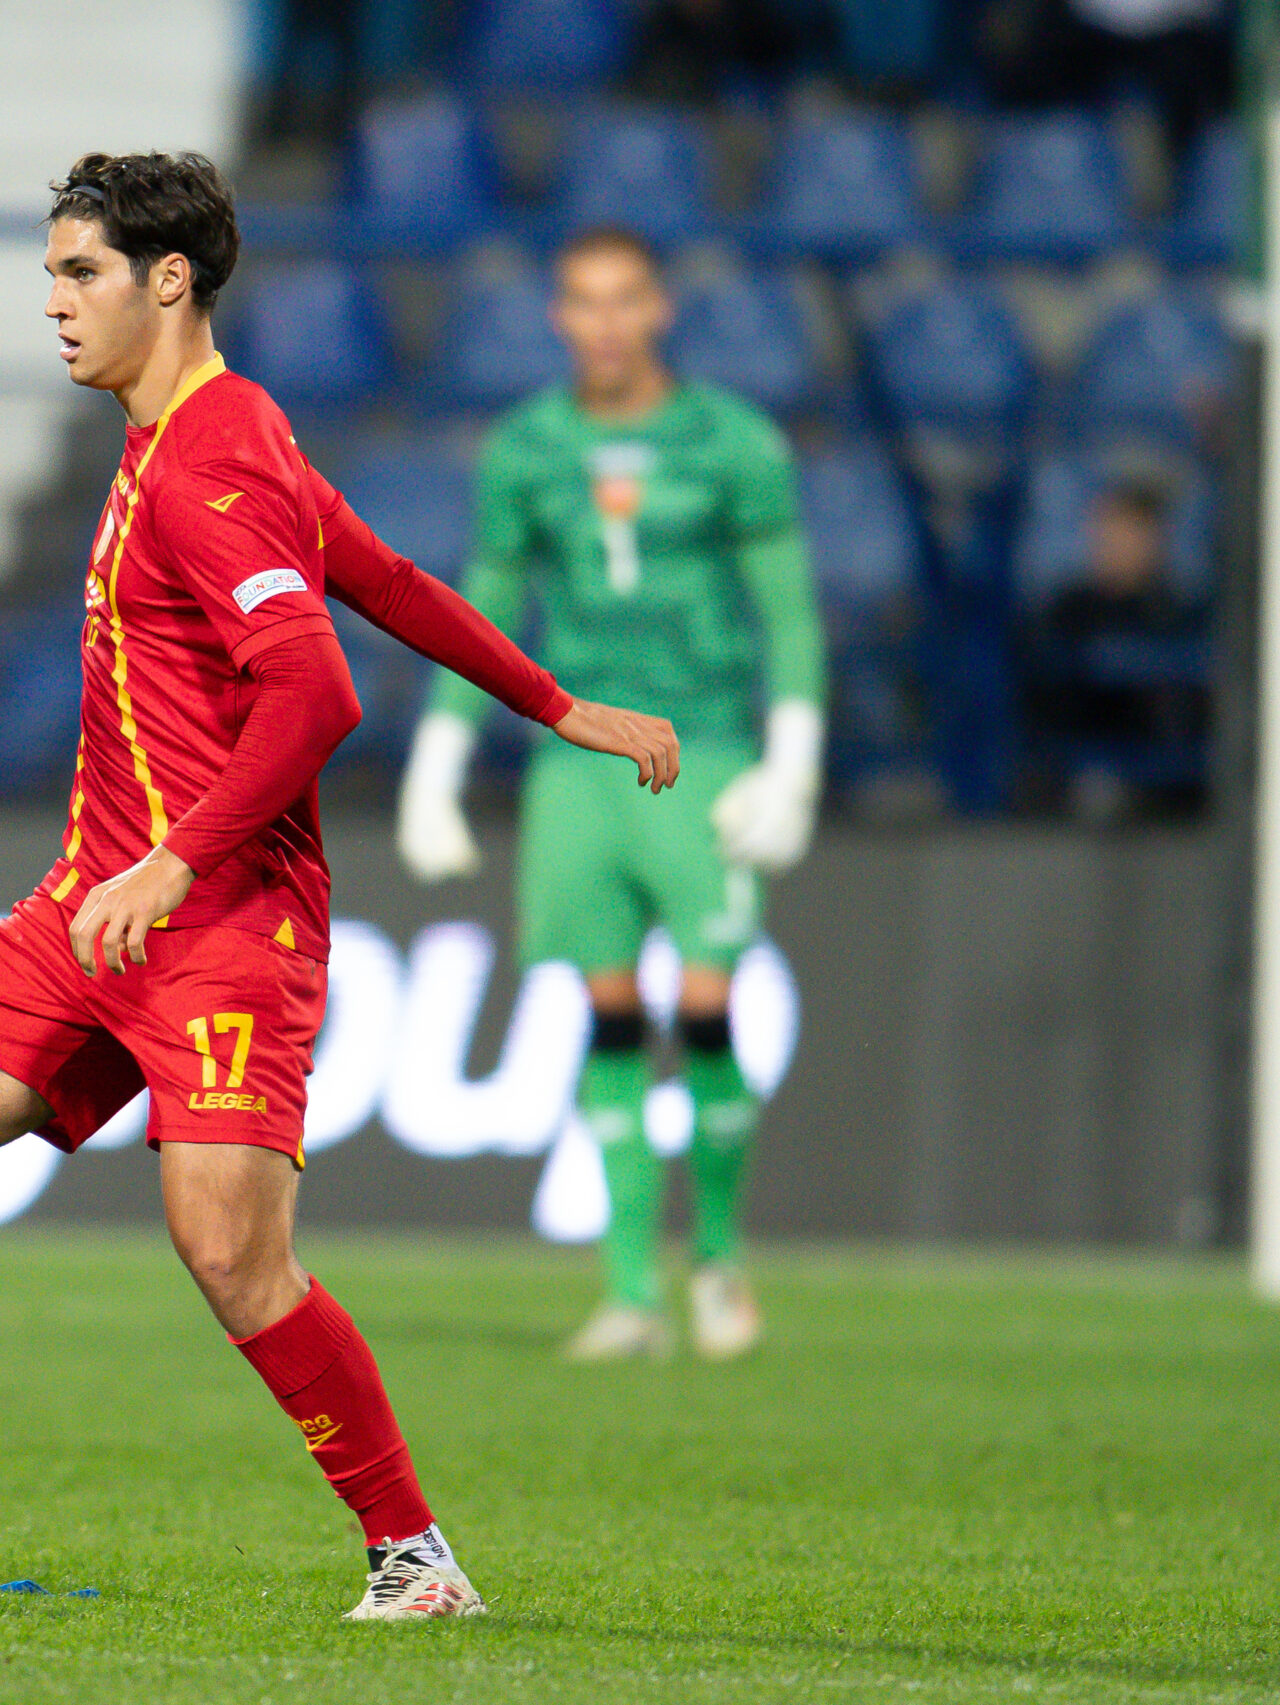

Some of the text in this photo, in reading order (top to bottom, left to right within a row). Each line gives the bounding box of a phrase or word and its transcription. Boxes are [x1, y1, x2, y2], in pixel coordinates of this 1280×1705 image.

[237, 575, 302, 605] FOUNDATION
[186, 1012, 254, 1088] 17
[188, 1092, 268, 1114] LEGEA
